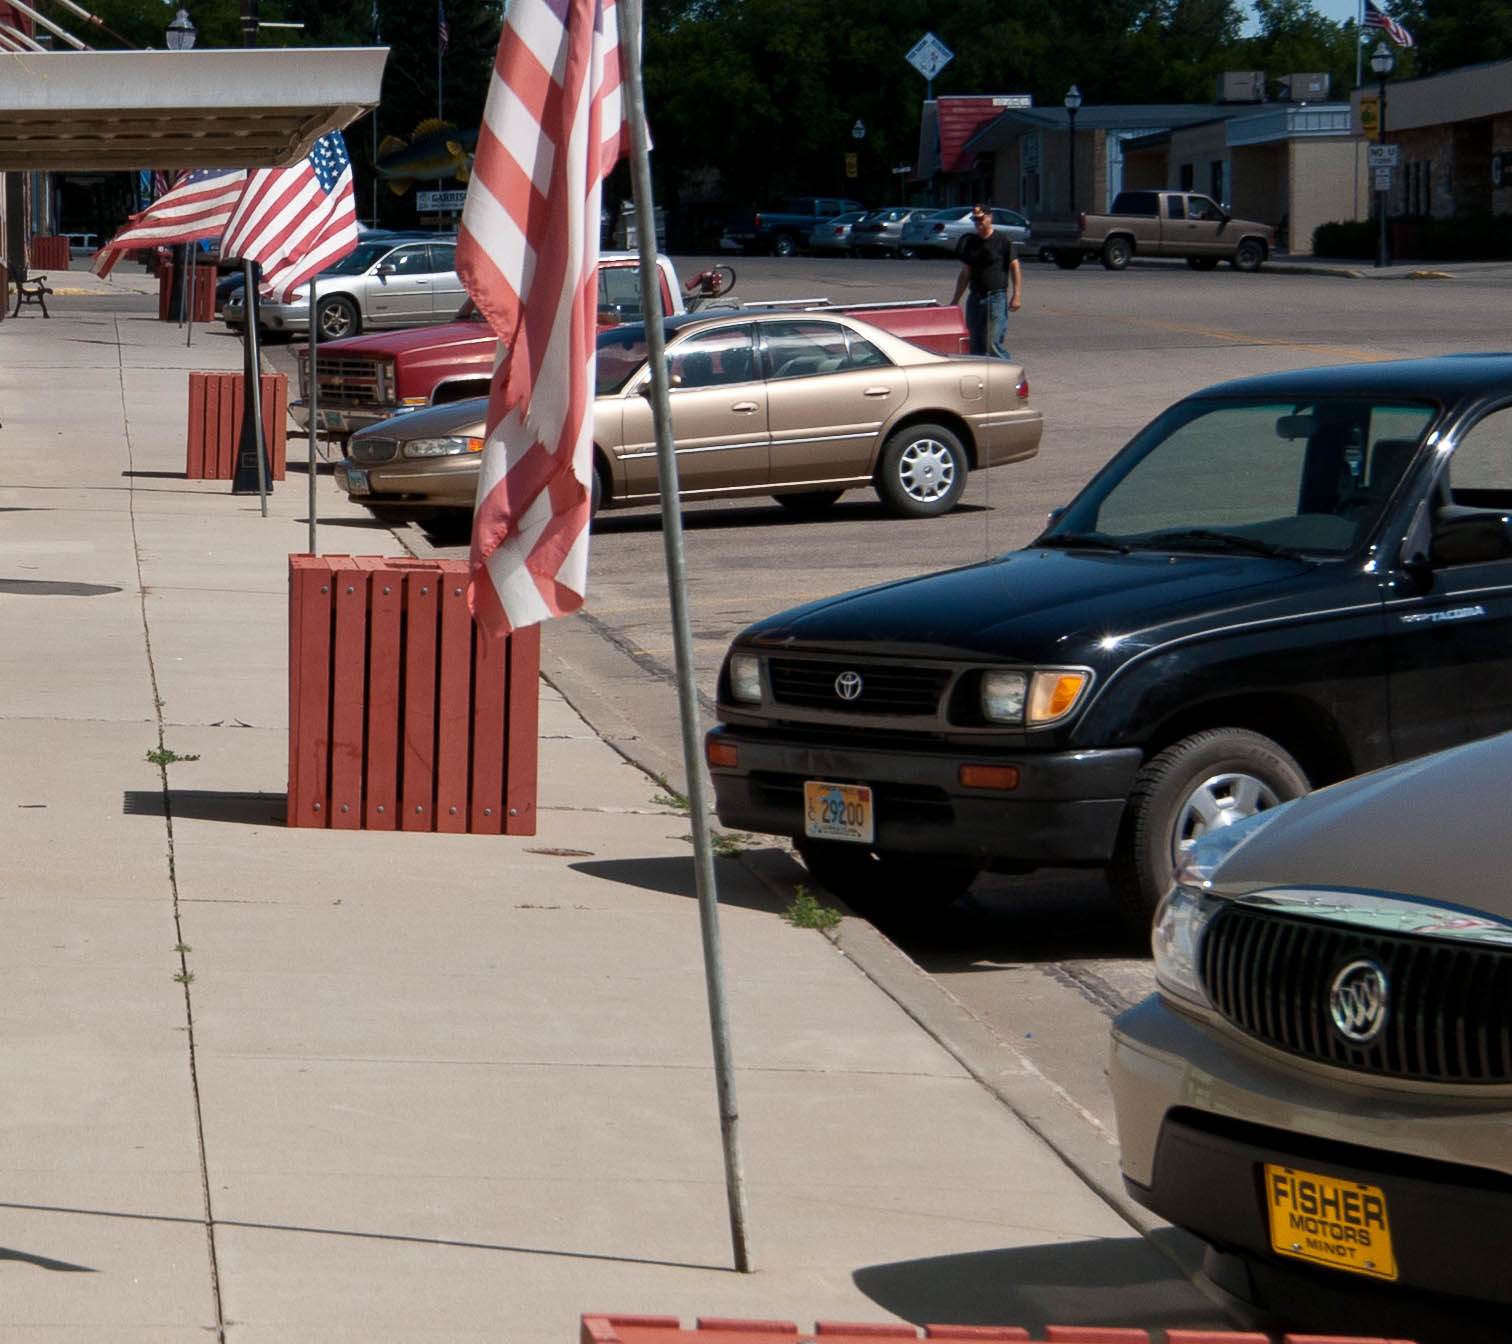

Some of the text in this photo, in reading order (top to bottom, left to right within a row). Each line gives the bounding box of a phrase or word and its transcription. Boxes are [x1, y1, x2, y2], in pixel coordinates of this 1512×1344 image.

[431, 191, 465, 202] GARRIS
[821, 799, 864, 827] 29200
[1273, 1174, 1385, 1231] FISHER
[1289, 1212, 1371, 1247] MOTORS
[1305, 1237, 1357, 1259] MINOT
